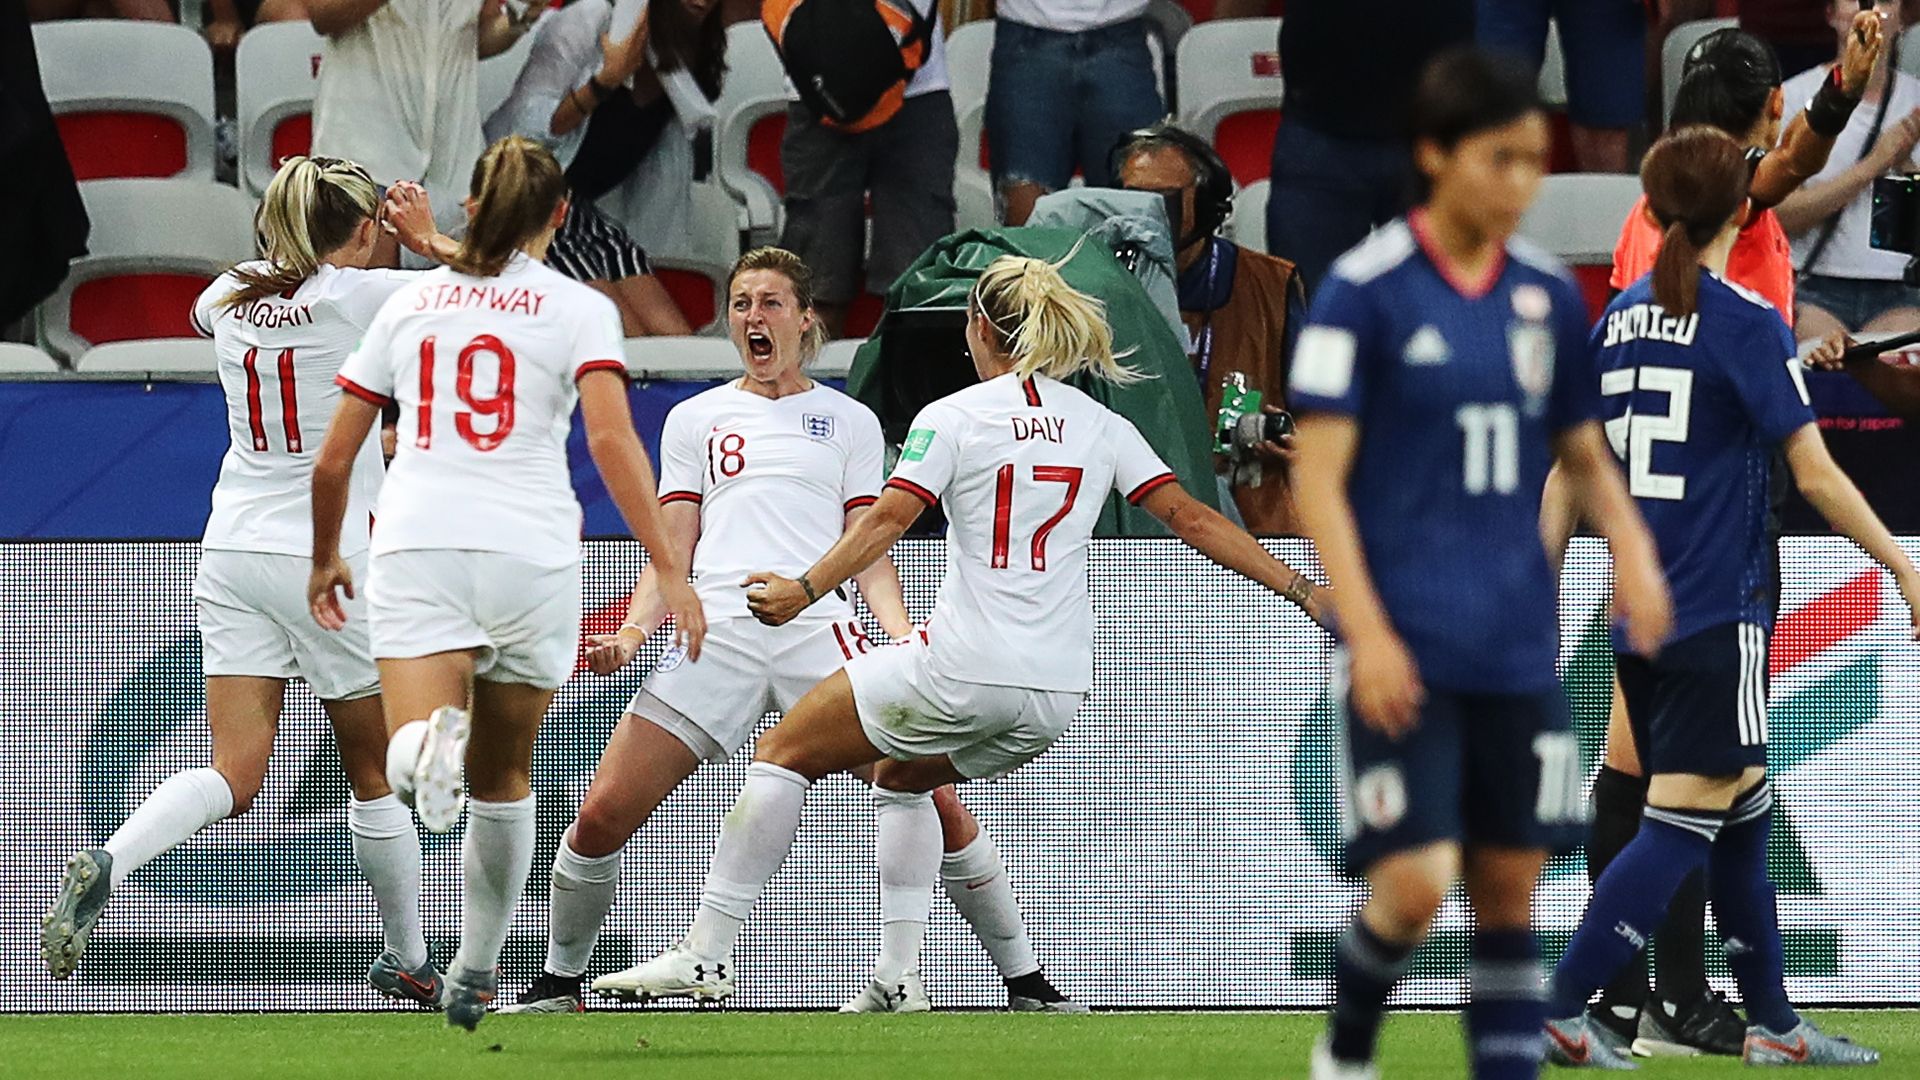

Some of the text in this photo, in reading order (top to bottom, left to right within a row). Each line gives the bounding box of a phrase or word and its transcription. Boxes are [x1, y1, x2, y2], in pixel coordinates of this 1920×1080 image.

[414, 283, 547, 316] STANWAY
[243, 346, 303, 453] 11
[415, 333, 516, 451] 19
[1011, 416, 1065, 444] DALY
[708, 433, 745, 485] 18
[1454, 402, 1519, 496] 11
[991, 463, 1084, 572] 17
